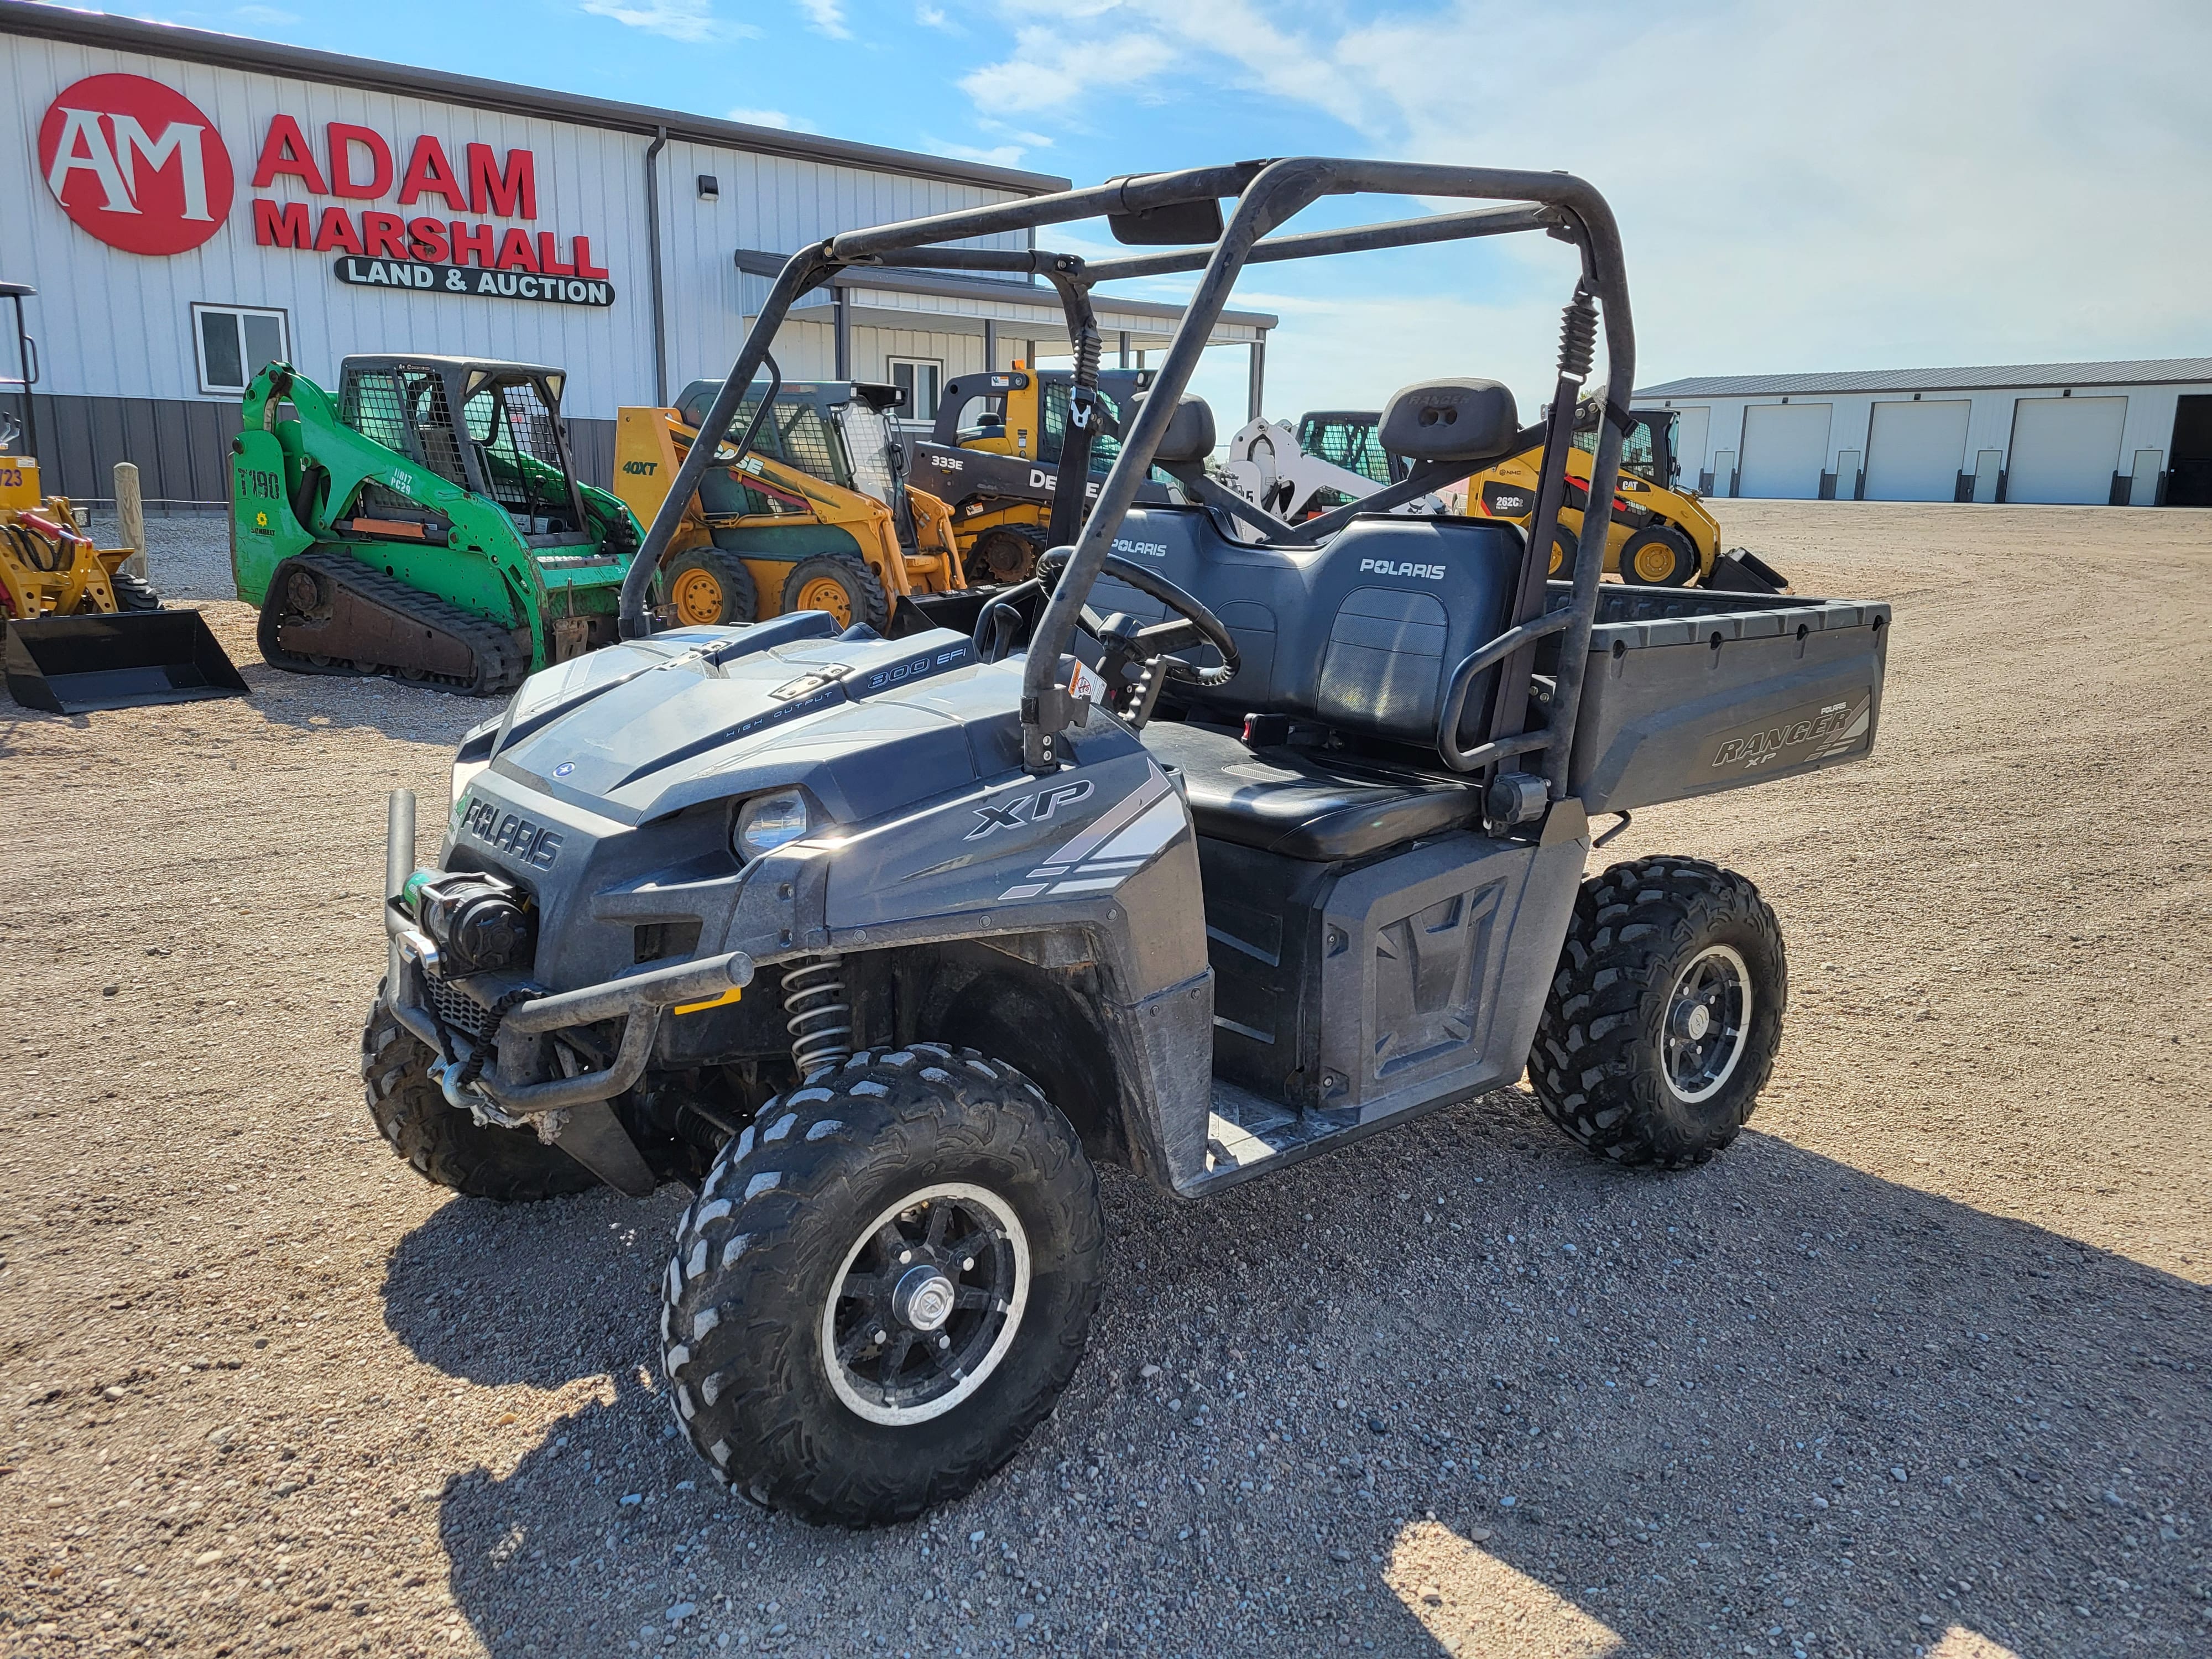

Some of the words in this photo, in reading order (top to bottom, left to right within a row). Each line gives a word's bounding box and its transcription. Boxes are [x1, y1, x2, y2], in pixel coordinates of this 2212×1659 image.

[46, 106, 215, 222] AM
[252, 114, 537, 220] ADAM
[253, 199, 608, 279] MARSHALL
[347, 258, 434, 288] LAND
[446, 268, 468, 291] &
[477, 270, 607, 304] AUCTION
[622, 461, 658, 476] 40XT
[931, 455, 964, 471] 333E
[238, 467, 280, 500] T190
[390, 476, 411, 495] PC29
[1029, 468, 1099, 498] DEE
[1622, 481, 1638, 491] CAT
[1359, 558, 1446, 580] POLARIS
[936, 648, 967, 665] EFI
[726, 718, 764, 738] HIGH
[773, 691, 833, 718] OUTPUT
[1820, 702, 1847, 715] POLARIS
[1712, 708, 1853, 767] RANGER
[1744, 752, 1777, 769] XP
[962, 780, 1095, 842] XP
[460, 797, 564, 872] POLARIS
